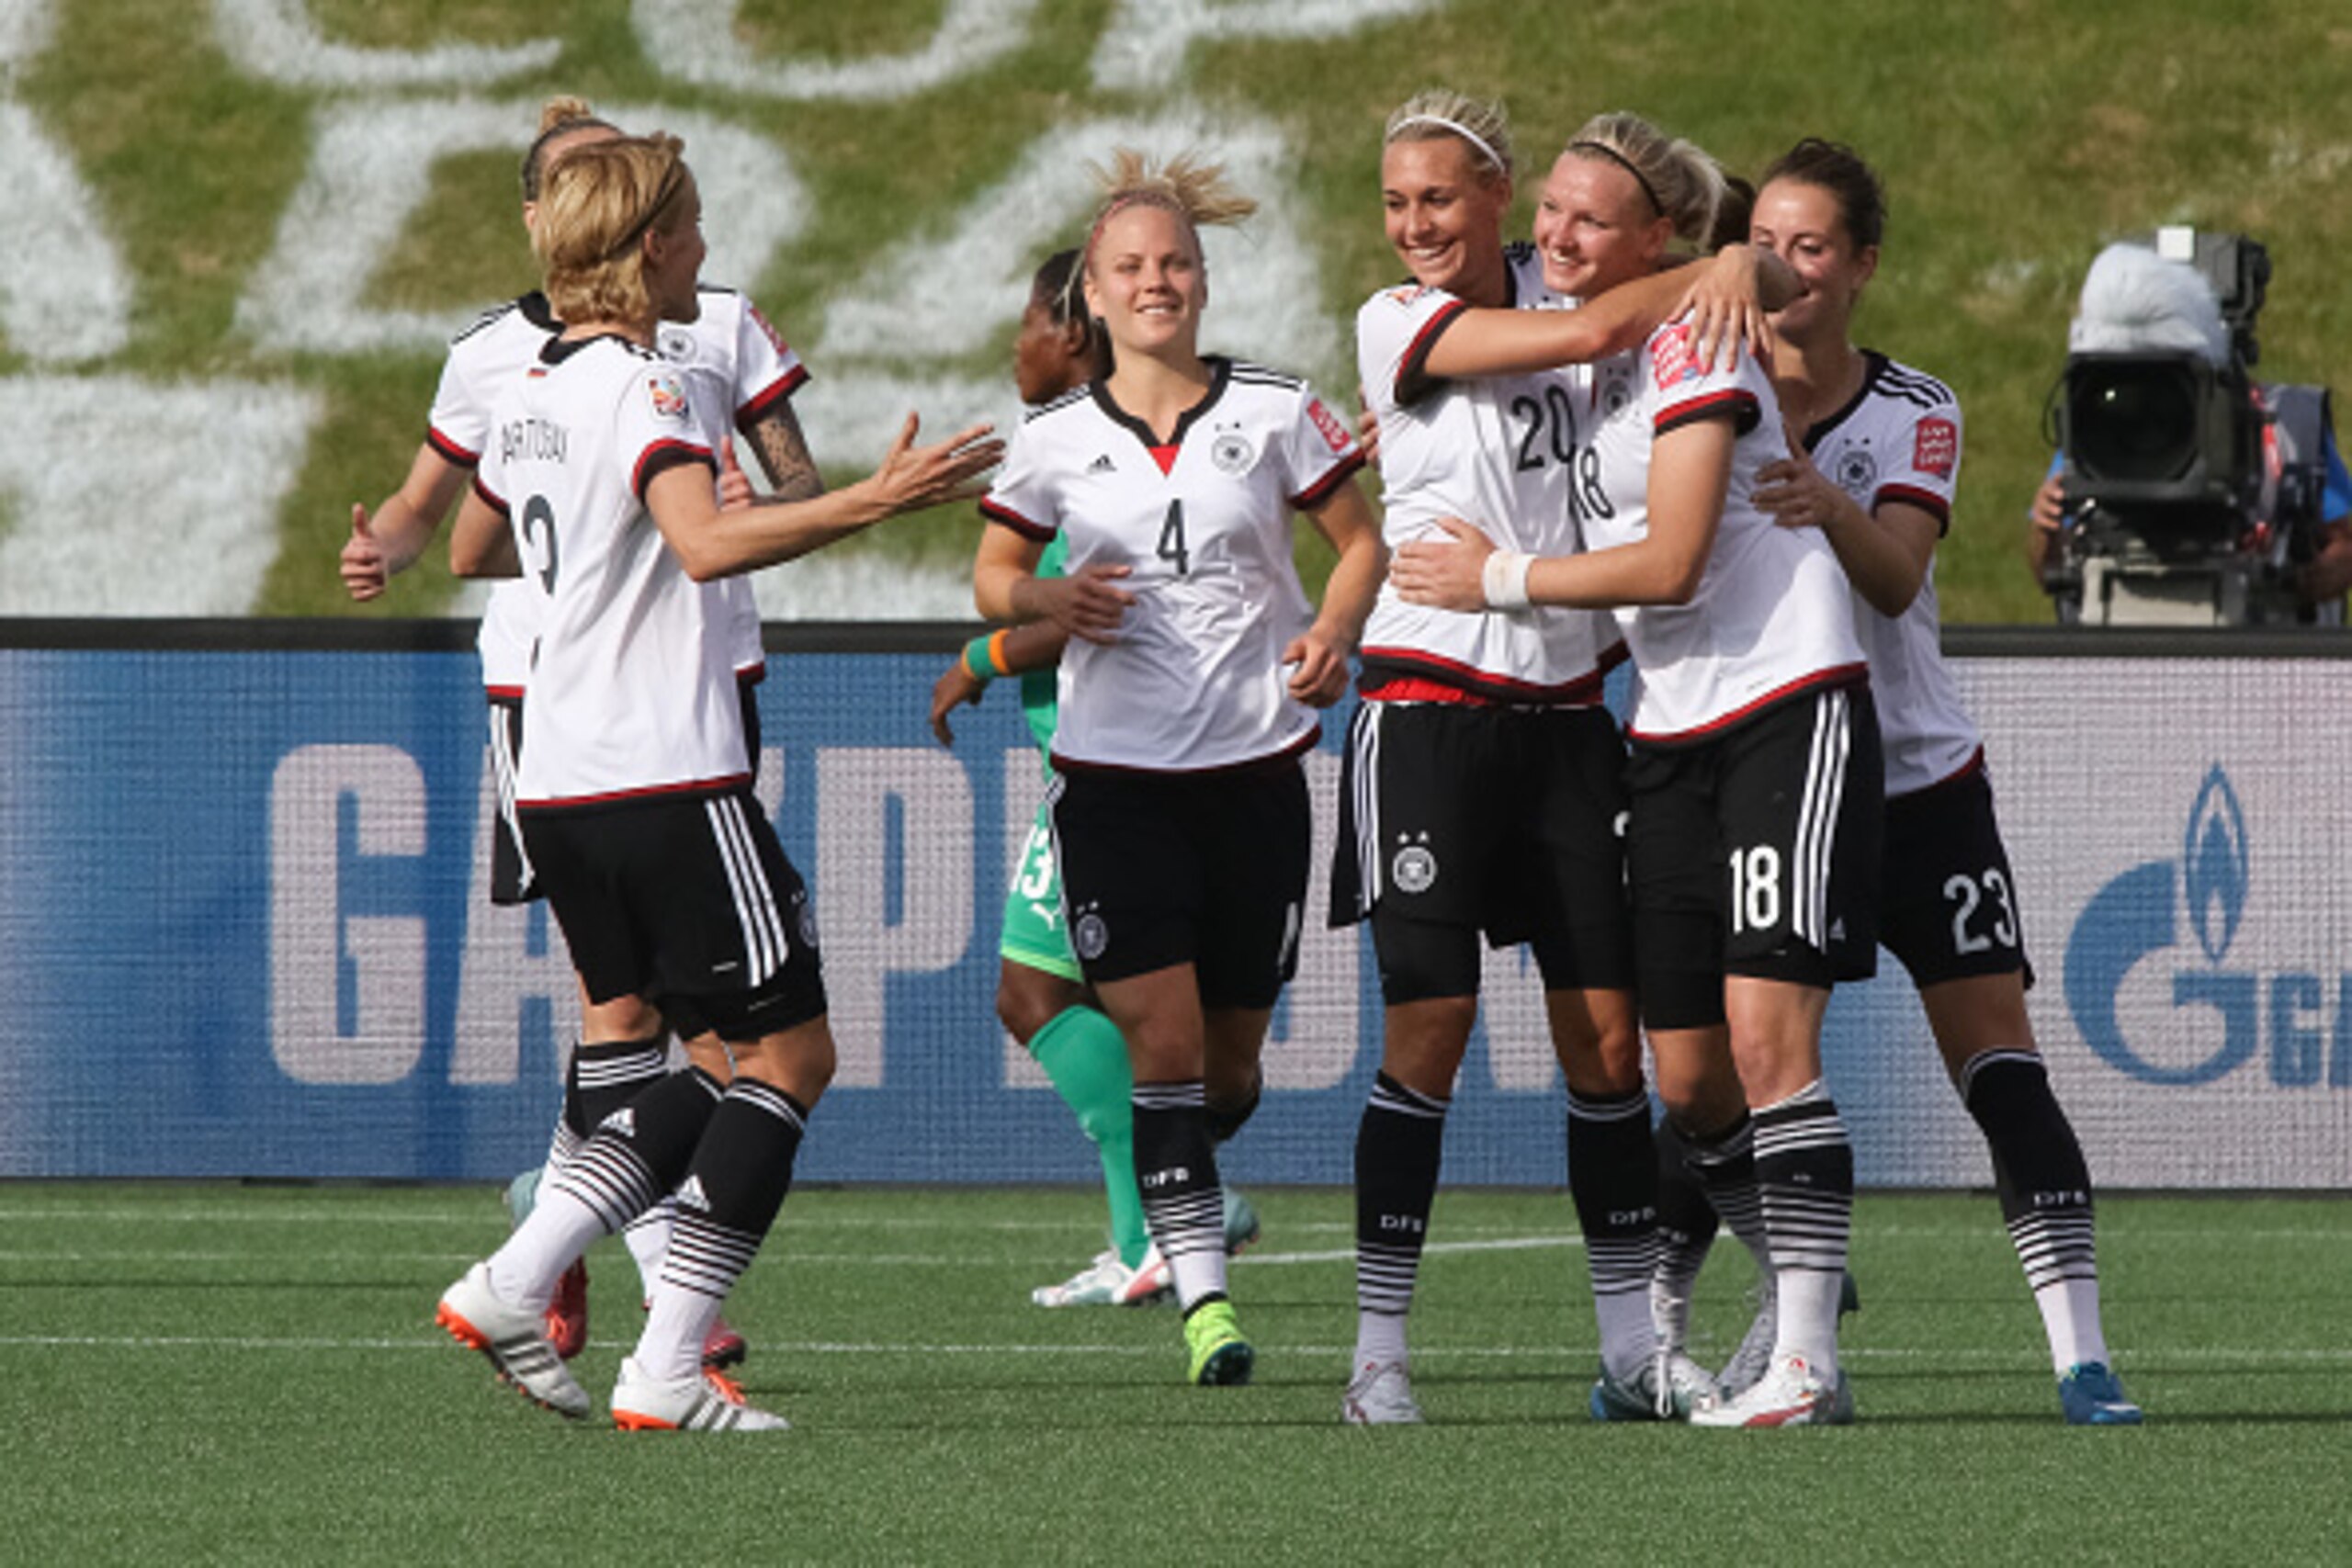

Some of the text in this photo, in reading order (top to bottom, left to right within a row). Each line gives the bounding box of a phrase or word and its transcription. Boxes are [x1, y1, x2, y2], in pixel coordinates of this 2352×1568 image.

[1511, 383, 1577, 471] 20
[1157, 497, 1188, 575] 4
[1729, 844, 1780, 935] 18
[1942, 867, 2018, 955] 23
